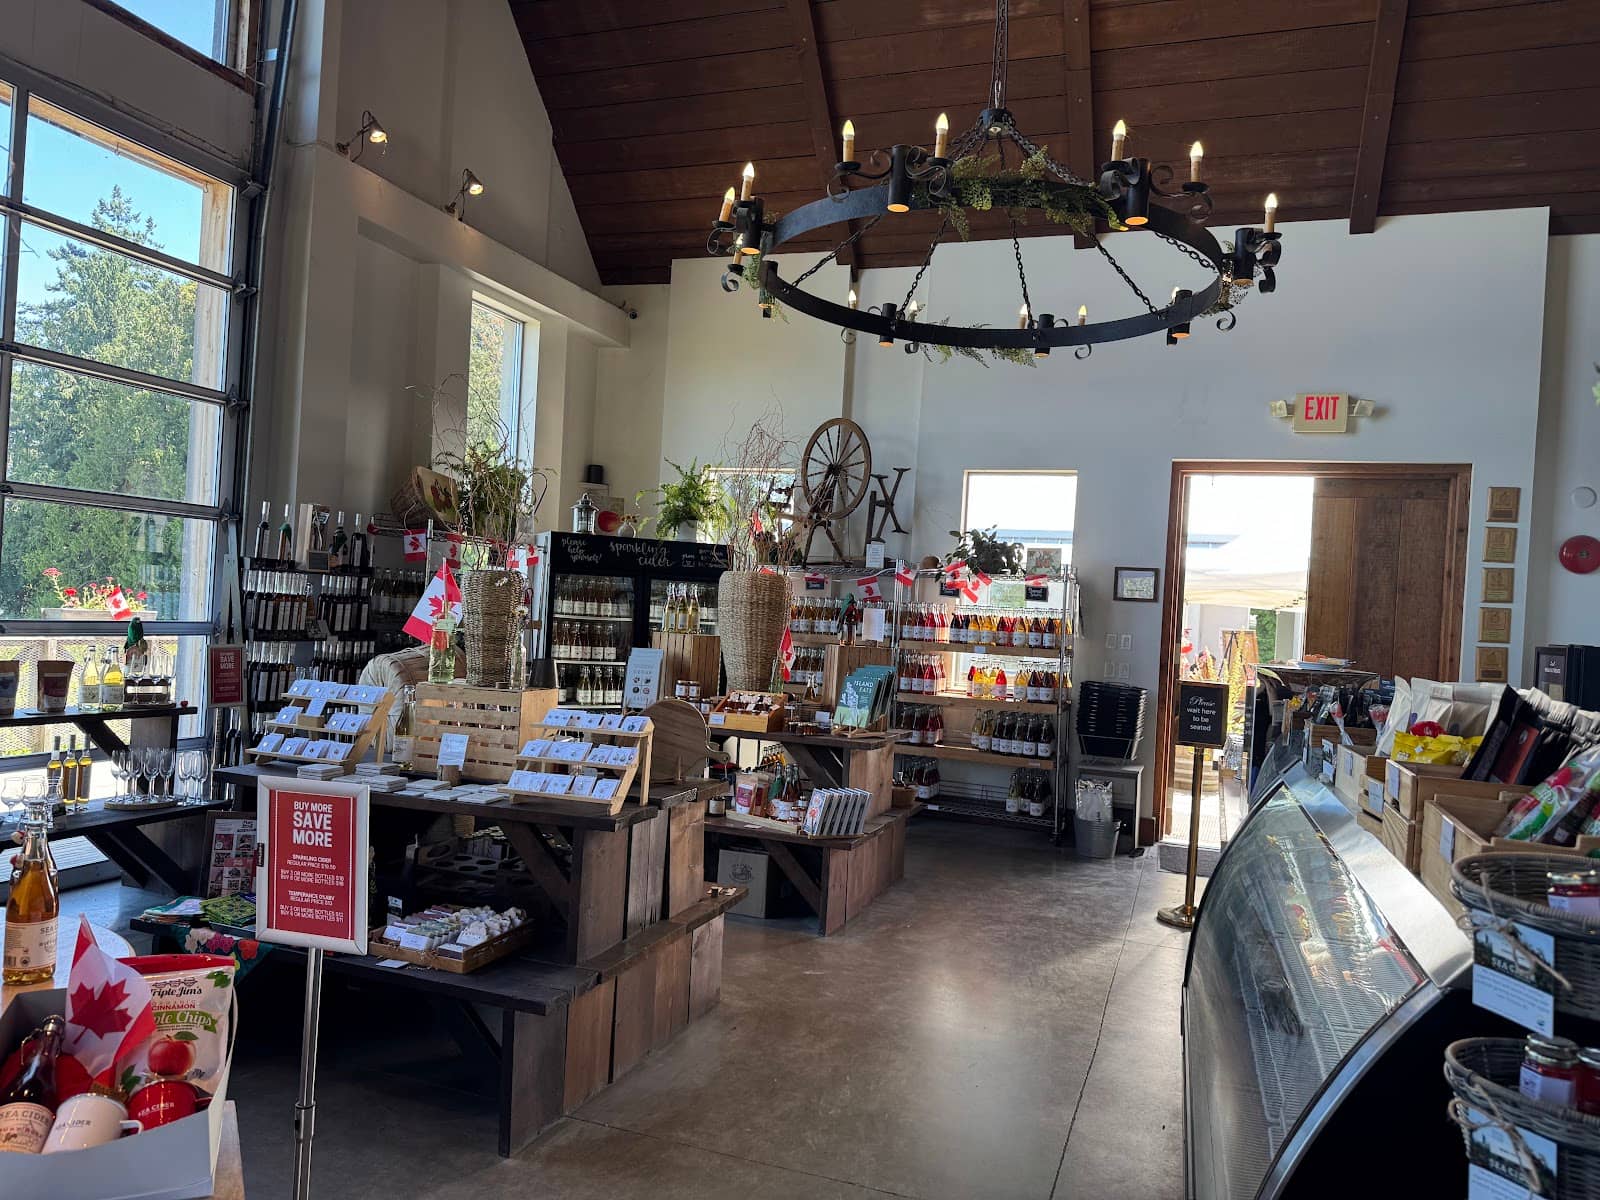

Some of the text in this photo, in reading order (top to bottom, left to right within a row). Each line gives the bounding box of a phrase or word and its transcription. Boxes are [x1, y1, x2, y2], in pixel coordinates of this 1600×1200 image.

[1305, 396, 1339, 420] EXIT
[609, 541, 667, 557] sparkling
[639, 556, 672, 568] cider
[293, 801, 333, 813] BUY MORE
[293, 811, 333, 831] SAVE
[292, 829, 333, 848] MORE
[292, 853, 317, 862] SPARKLING
[286, 859, 307, 867] REGULAR
[307, 861, 320, 869] PRICE
[301, 876, 314, 884] MORE
[315, 878, 335, 886] BOTTLES
[315, 872, 335, 880] BOTTLES
[288, 890, 319, 899] TEMPERANCE
[290, 895, 310, 903] REGULAR
[315, 908, 335, 916] BOTTLES
[315, 914, 335, 922] BOTTLES
[151, 985, 202, 998] Triple Jim's
[151, 1003, 196, 1011] CINNAMON
[176, 1010, 212, 1028] Chips
